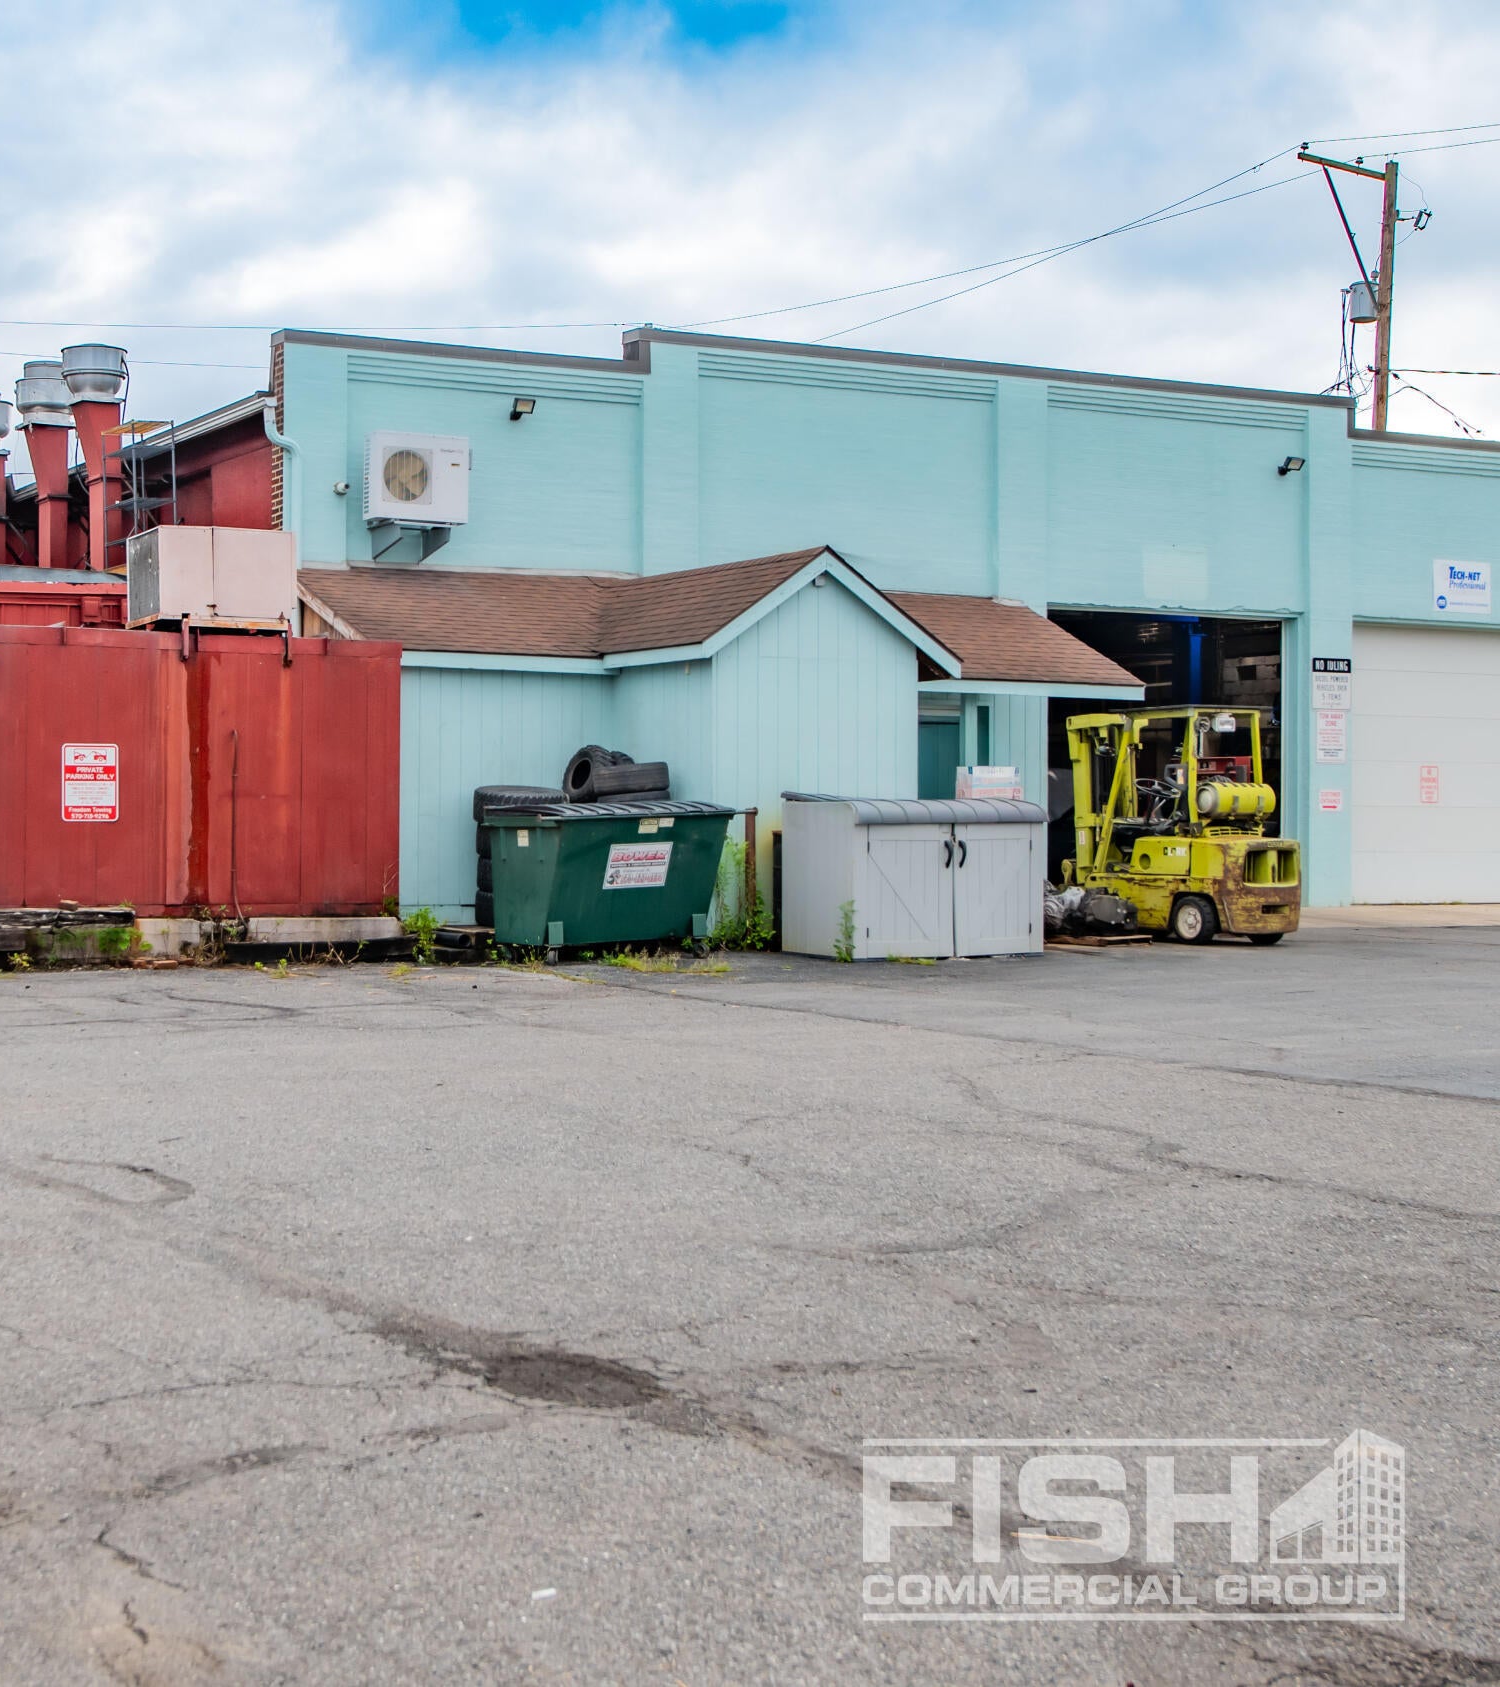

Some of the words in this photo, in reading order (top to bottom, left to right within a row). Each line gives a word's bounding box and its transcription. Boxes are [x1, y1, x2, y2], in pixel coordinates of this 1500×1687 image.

[1448, 566, 1481, 581] TECH-NET
[1315, 660, 1325, 671] NO
[1327, 660, 1349, 672] IDLING
[611, 850, 667, 862] BOWER
